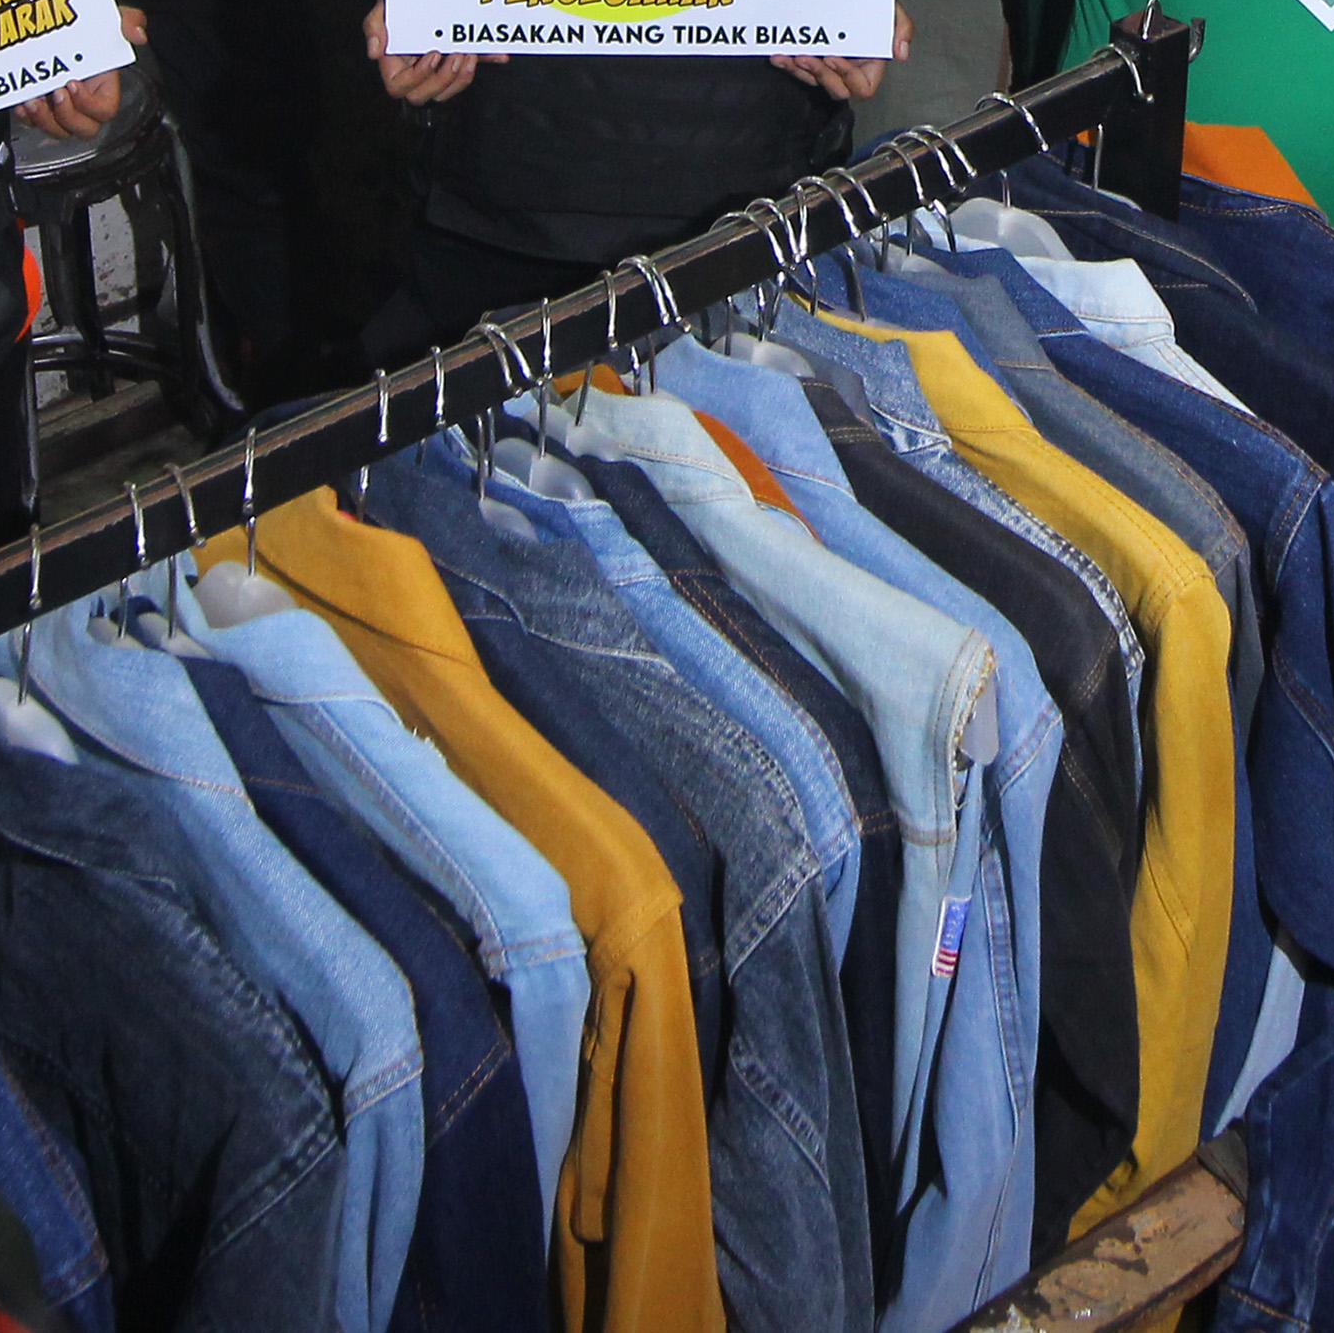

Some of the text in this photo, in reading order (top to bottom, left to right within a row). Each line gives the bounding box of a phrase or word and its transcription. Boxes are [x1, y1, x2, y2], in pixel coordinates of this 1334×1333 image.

[452, 24, 830, 45] BIASAKAN YANG TIDAK BIASA
